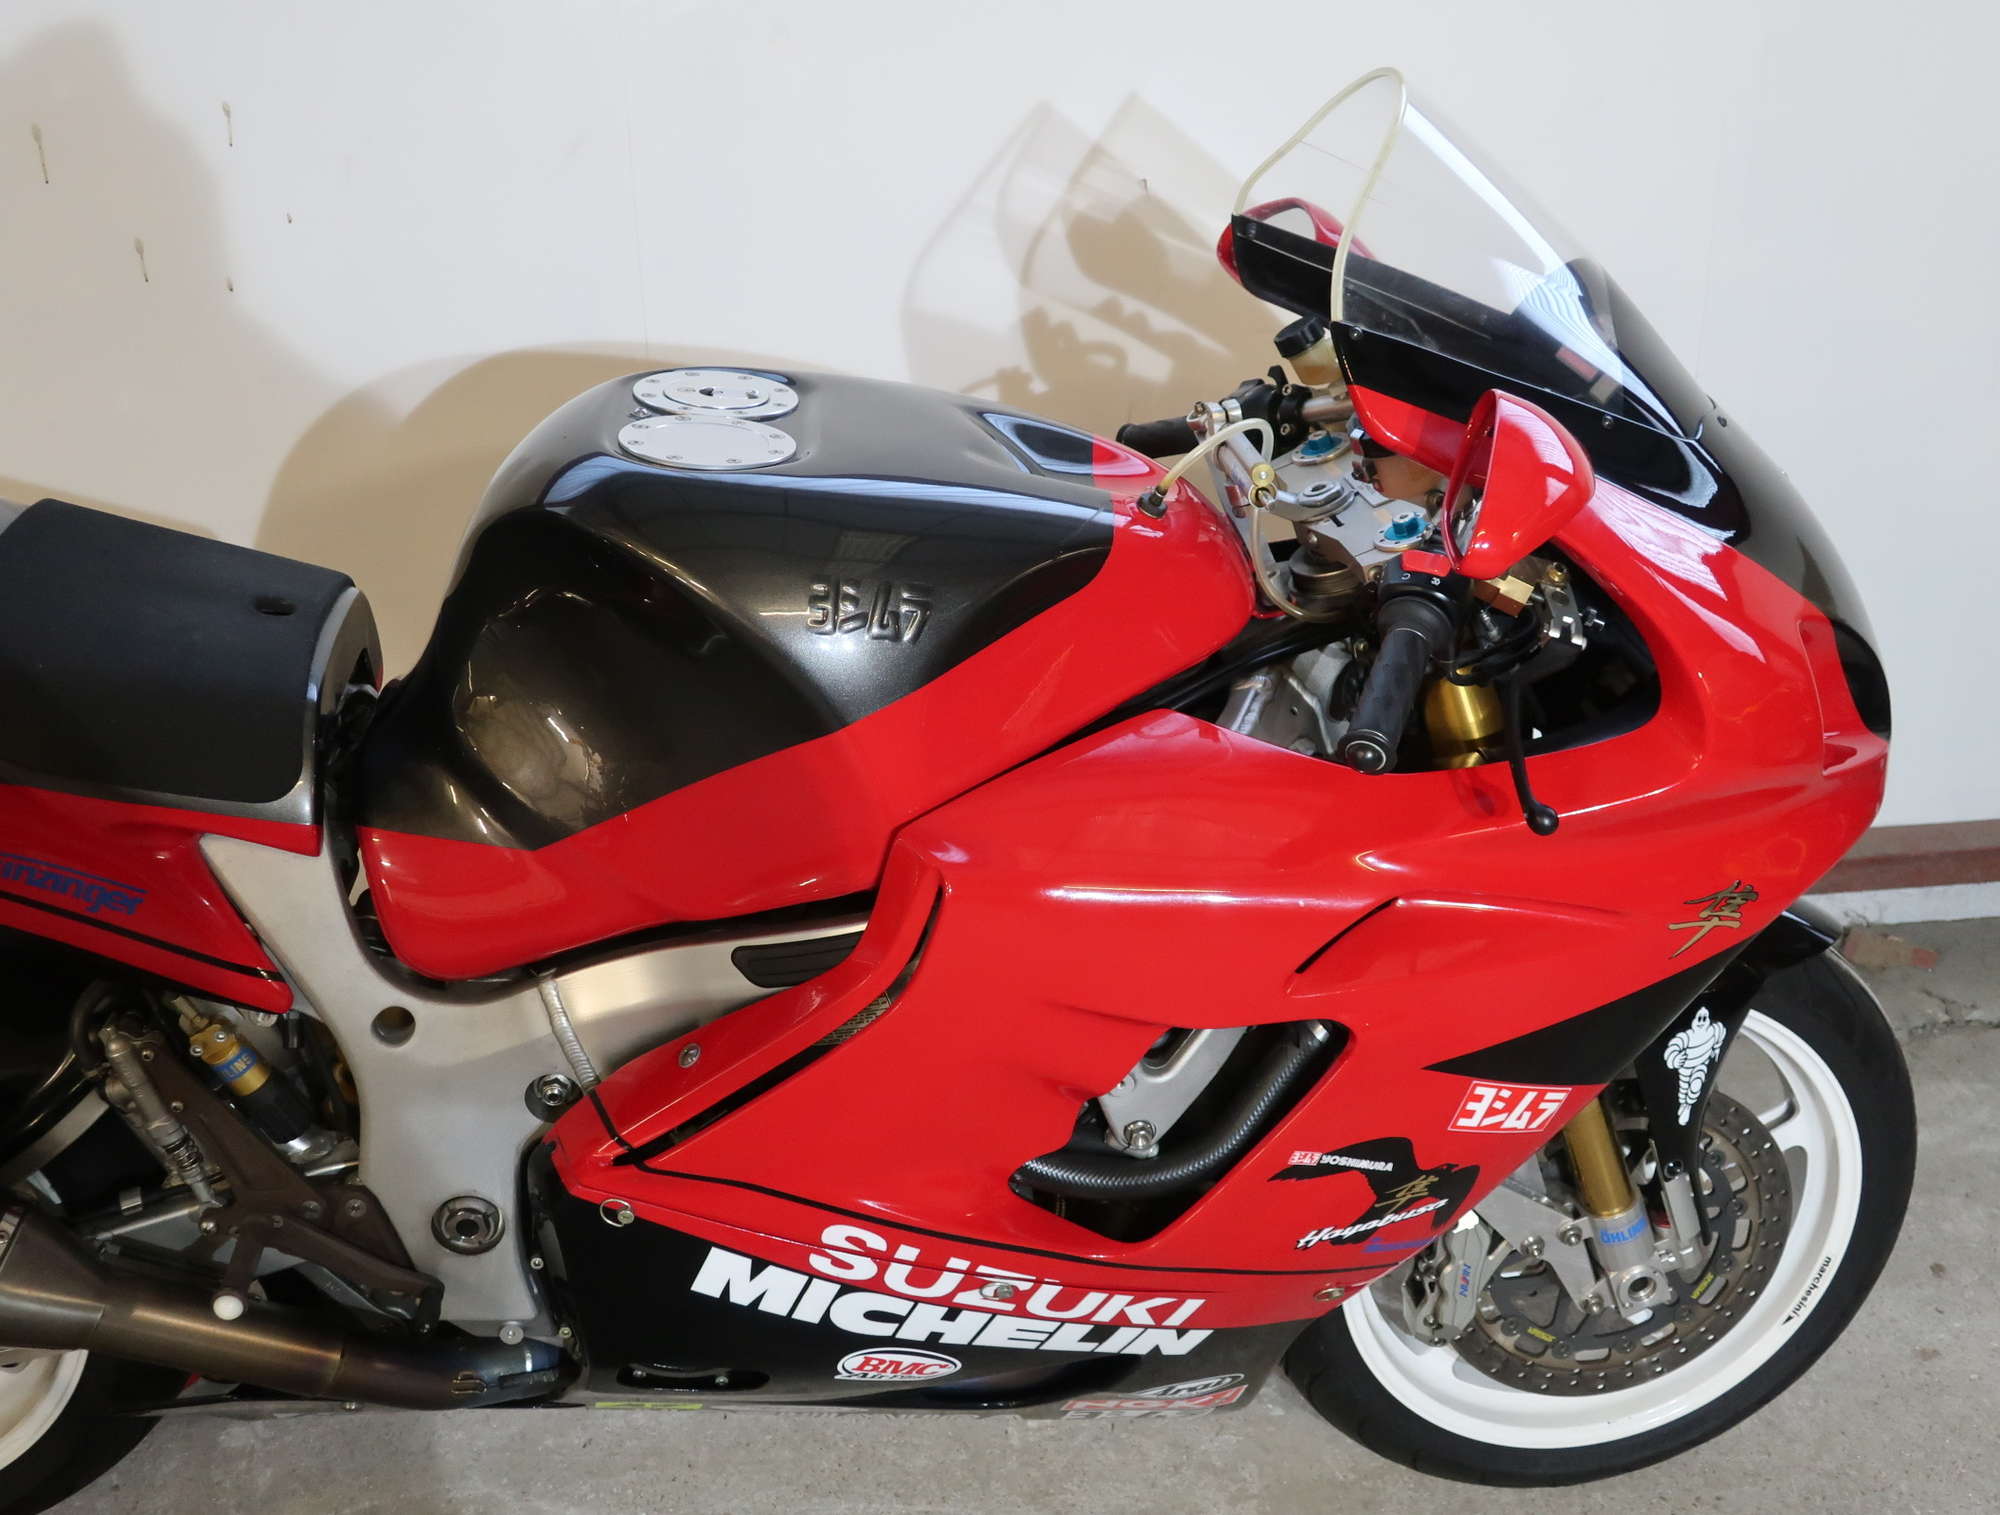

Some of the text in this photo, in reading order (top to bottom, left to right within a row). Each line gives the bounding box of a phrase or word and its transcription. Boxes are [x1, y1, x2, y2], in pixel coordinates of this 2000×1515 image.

[1456, 1086, 1569, 1130] ヨシムラ
[1320, 1154, 1393, 1171] YOSHIMURA
[1296, 1198, 1449, 1250] Hayabusa
[690, 1246, 1214, 1355] MICHELIN
[808, 1223, 1206, 1327] SUZUKI
[1792, 1256, 1832, 1318] marchesini
[852, 1356, 950, 1375] BMC
